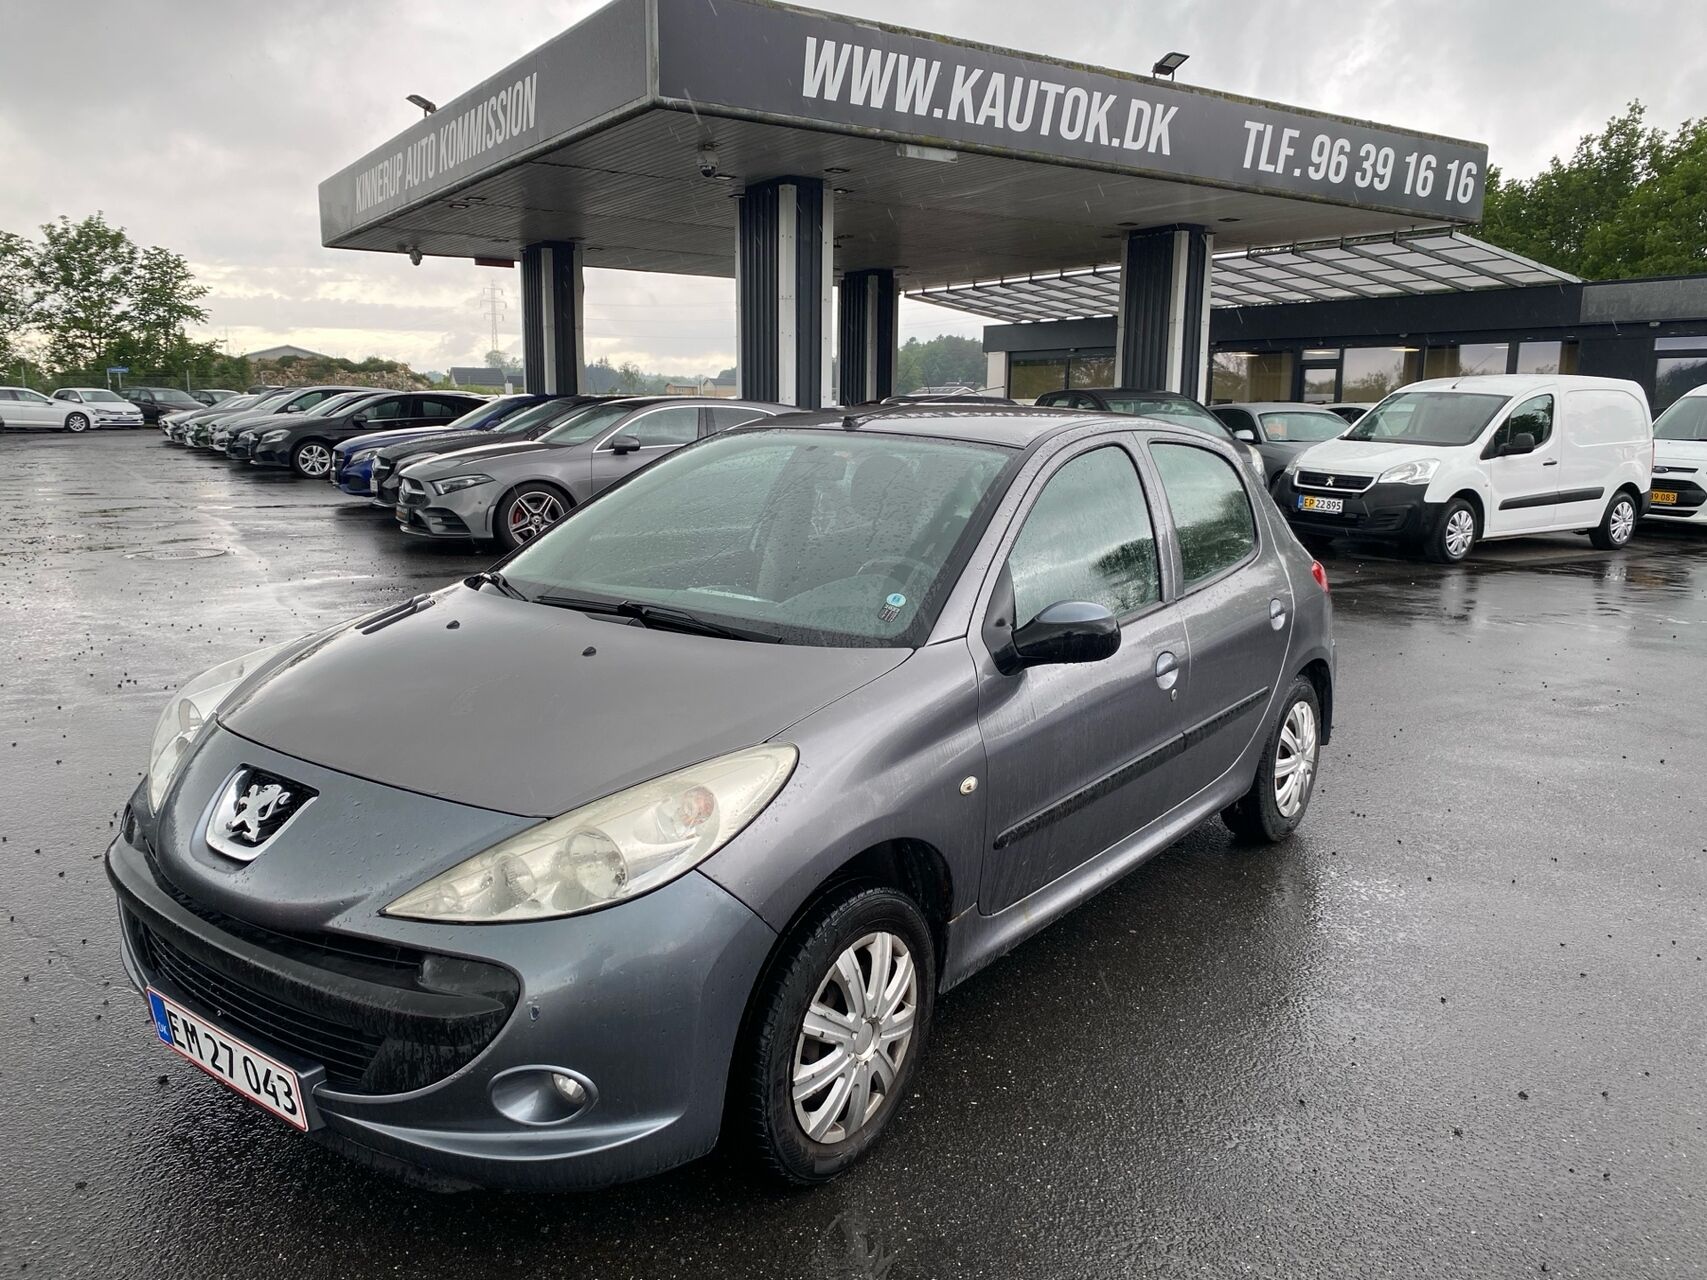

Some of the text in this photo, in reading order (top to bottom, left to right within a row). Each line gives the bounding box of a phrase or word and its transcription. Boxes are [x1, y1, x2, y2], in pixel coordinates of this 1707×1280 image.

[355, 71, 538, 214] KINNERUP AUTO KOMMISSION
[802, 36, 1179, 156] WWW.KAUTOK.DK
[1242, 120, 1478, 204] TLF. 96 39 16 16
[1304, 498, 1342, 510] EP 22 895
[1660, 493, 1676, 502] 083
[166, 1009, 298, 1116] EM 27 043
